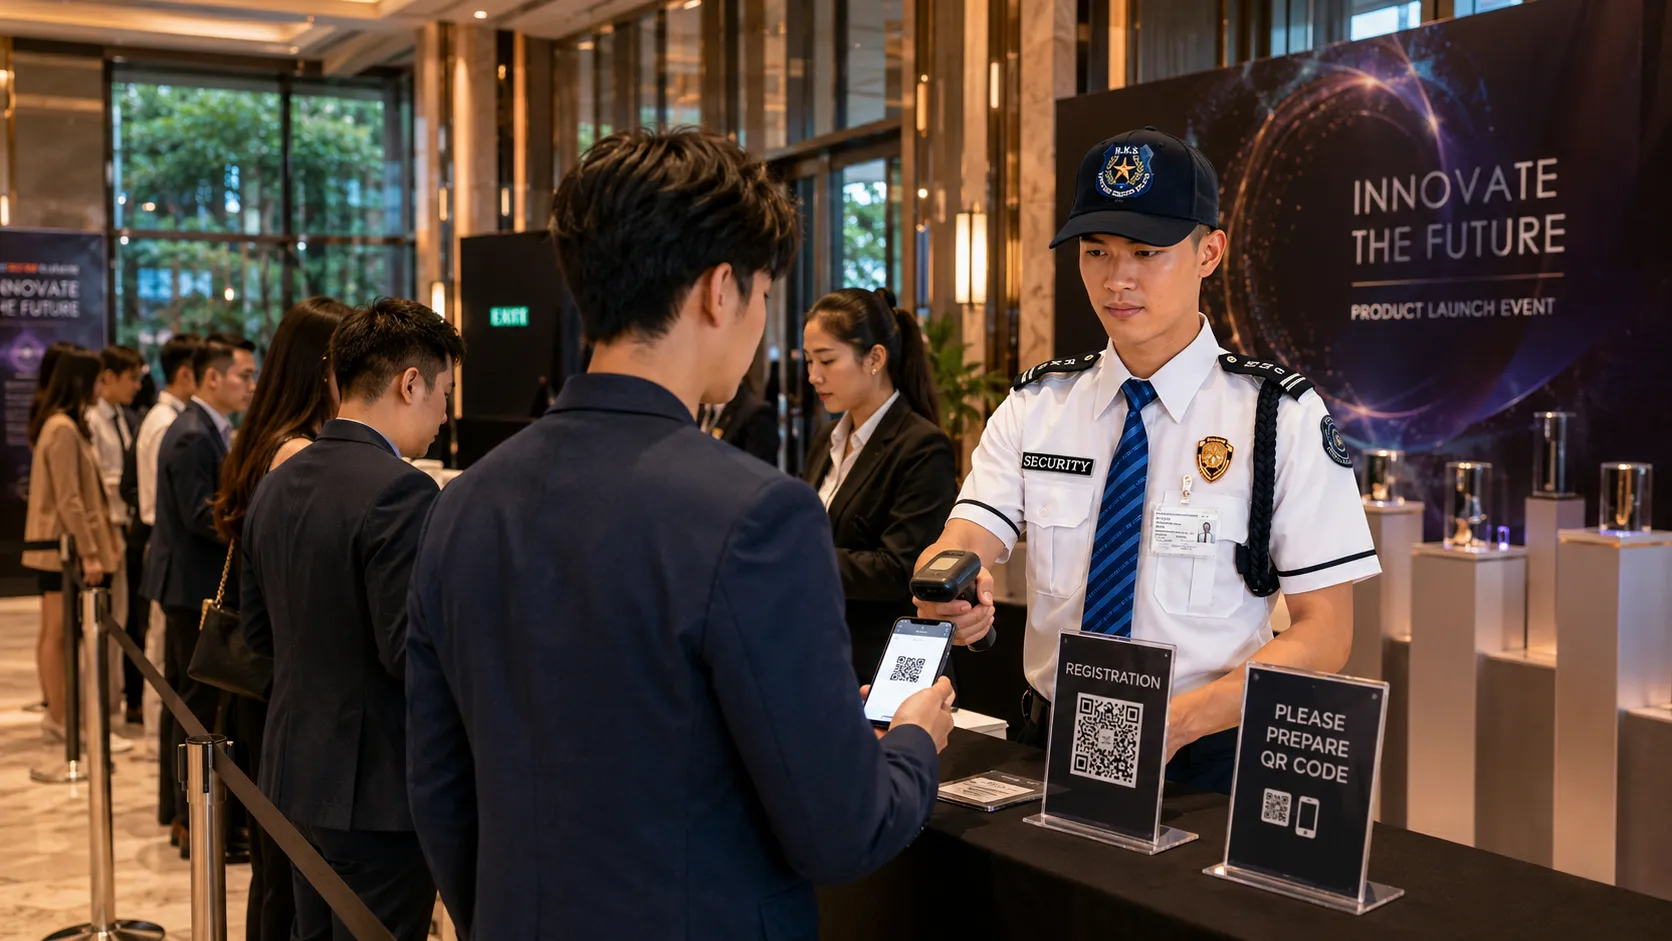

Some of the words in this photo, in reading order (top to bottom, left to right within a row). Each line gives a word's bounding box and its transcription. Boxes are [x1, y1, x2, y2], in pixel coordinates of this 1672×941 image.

[1354, 158, 1557, 216] INNOVATE
[1352, 226, 1412, 265] THE
[1426, 213, 1566, 260] FUTURE
[20, 299, 80, 318] FUTURE
[1351, 302, 1424, 320] PRODUCT
[1428, 300, 1495, 319] LAUNCH
[1500, 298, 1556, 316] EVENT
[1023, 455, 1091, 472] SECURITY
[1065, 662, 1161, 689] REGISTRATION
[1275, 703, 1346, 731] PLEASE
[1266, 726, 1350, 758] PREPARE
[1261, 750, 1288, 770] QR
[1293, 757, 1349, 784] CODE
